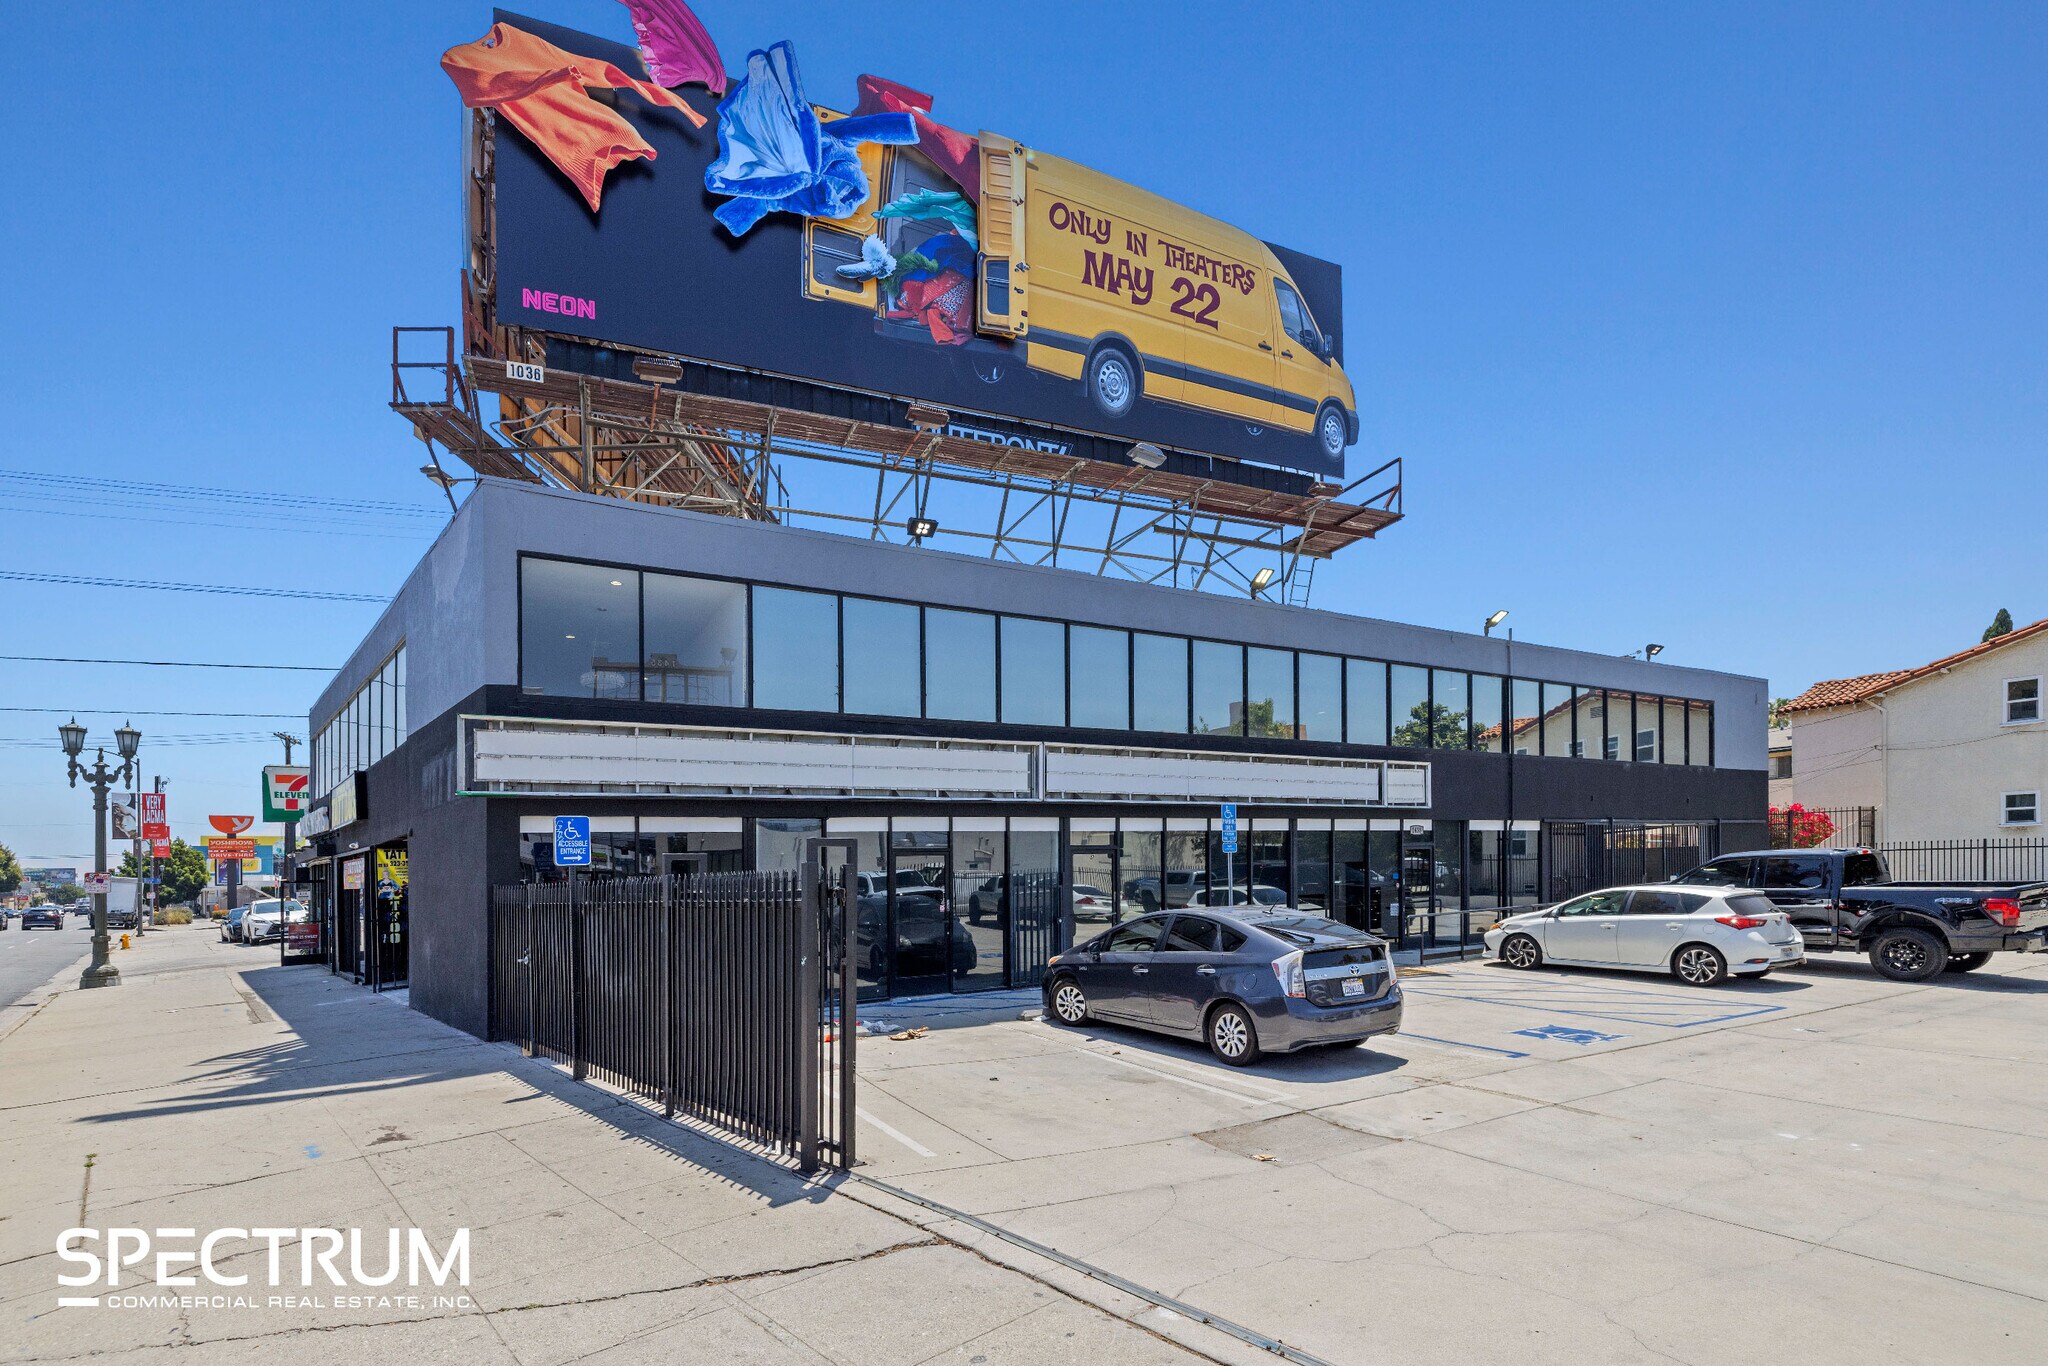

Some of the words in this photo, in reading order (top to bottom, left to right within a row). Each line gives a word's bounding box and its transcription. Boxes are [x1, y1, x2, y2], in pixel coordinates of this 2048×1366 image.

[1049, 202, 1111, 244] ONLY
[1126, 230, 1147, 257] IN
[1158, 239, 1256, 295] THEATERS
[522, 287, 596, 320] NEON
[1081, 249, 1154, 305] MAY
[1170, 277, 1219, 331] 22
[510, 364, 541, 381] 1036
[145, 795, 162, 809] VERY
[275, 774, 308, 810] 7
[143, 810, 164, 824] LACMA
